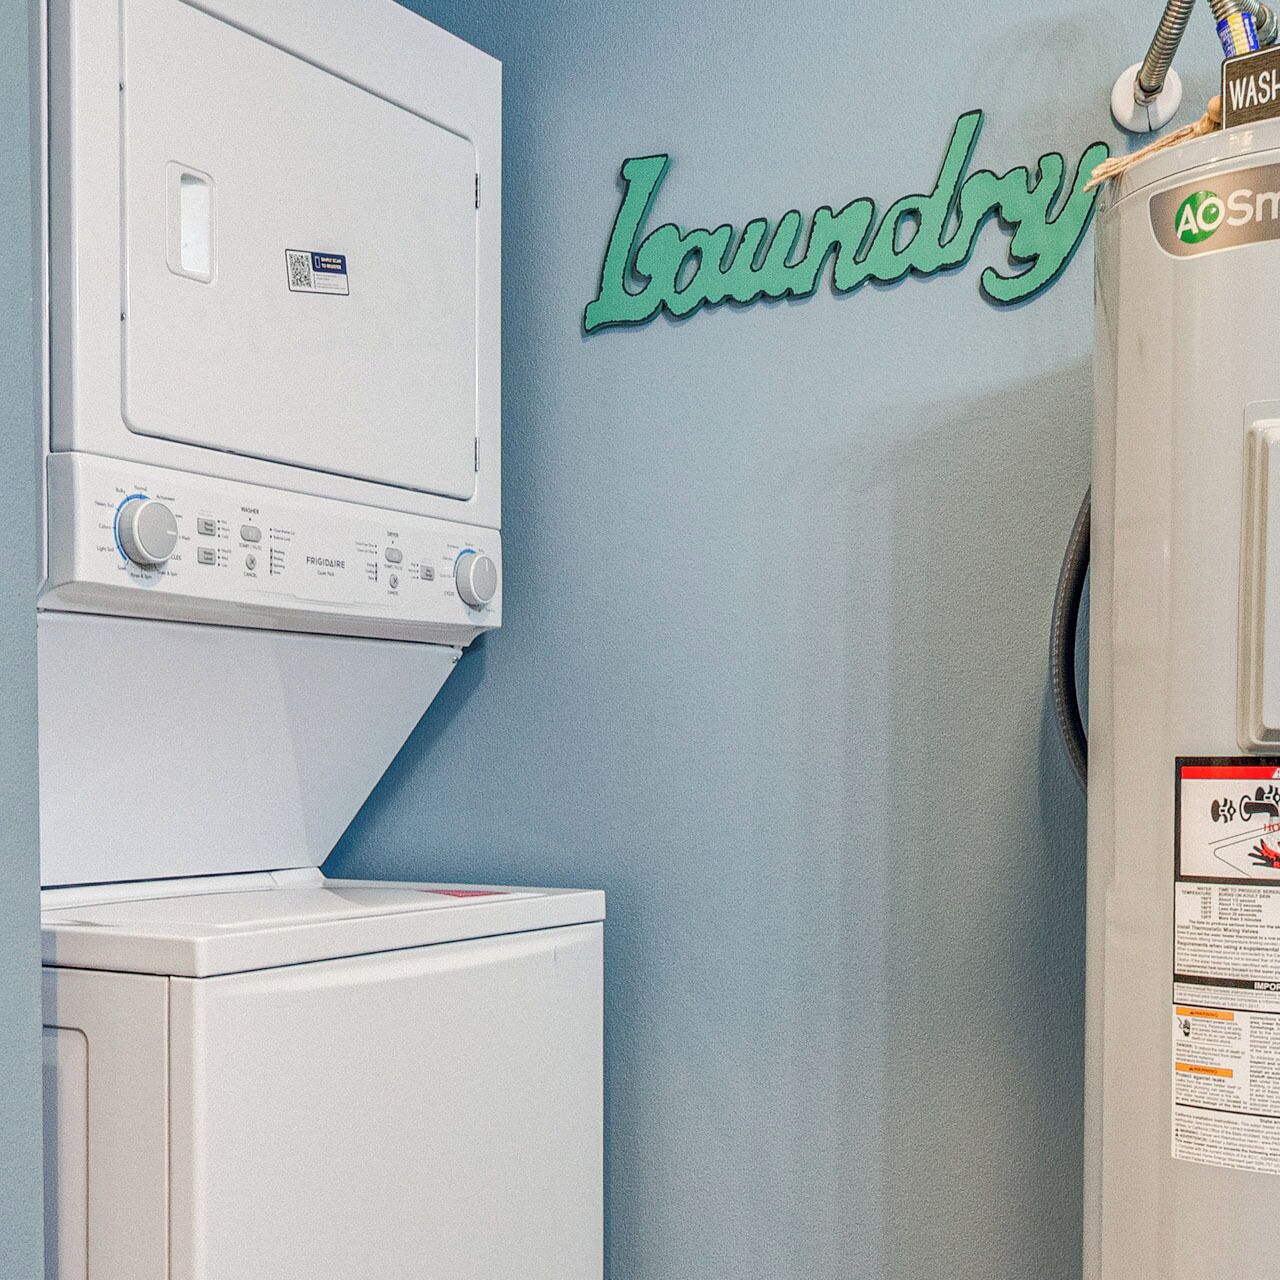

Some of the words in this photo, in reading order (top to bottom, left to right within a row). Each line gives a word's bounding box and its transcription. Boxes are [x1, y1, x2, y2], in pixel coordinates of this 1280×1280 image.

[583, 109, 1110, 336] Laundry
[241, 506, 259, 514] WASHER
[306, 556, 345, 569] FRIGIDAIRE
